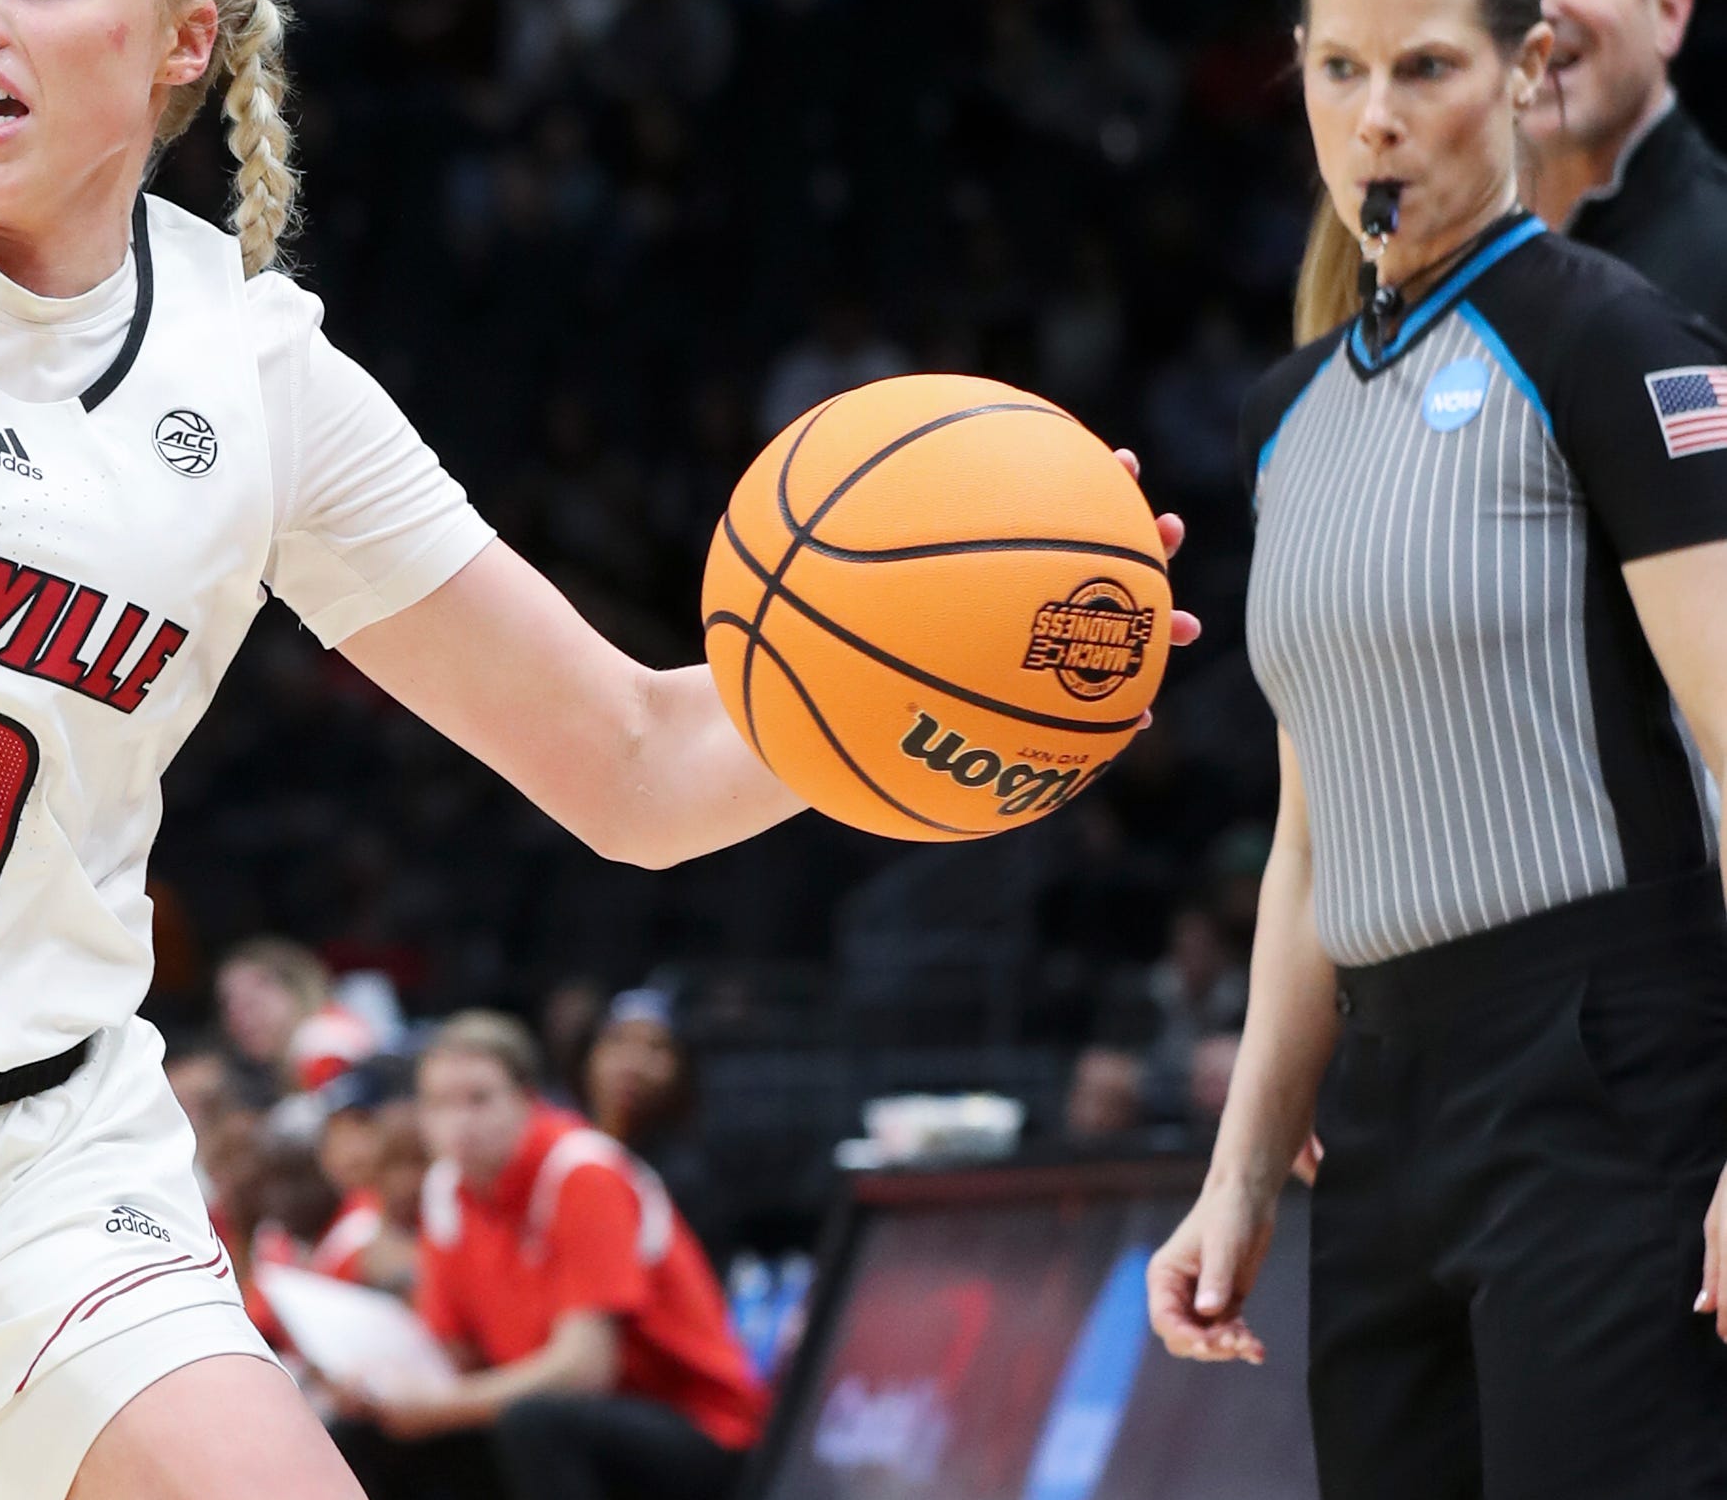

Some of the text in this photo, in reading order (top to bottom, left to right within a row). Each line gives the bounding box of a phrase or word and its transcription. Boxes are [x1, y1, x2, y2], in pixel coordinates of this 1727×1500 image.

[162, 430, 216, 452] ACC
[1033, 609, 1131, 644] MADNESS
[1063, 641, 1134, 673] MARCH
[1015, 746, 1056, 763] NXT
[105, 1215, 171, 1243] adidas
